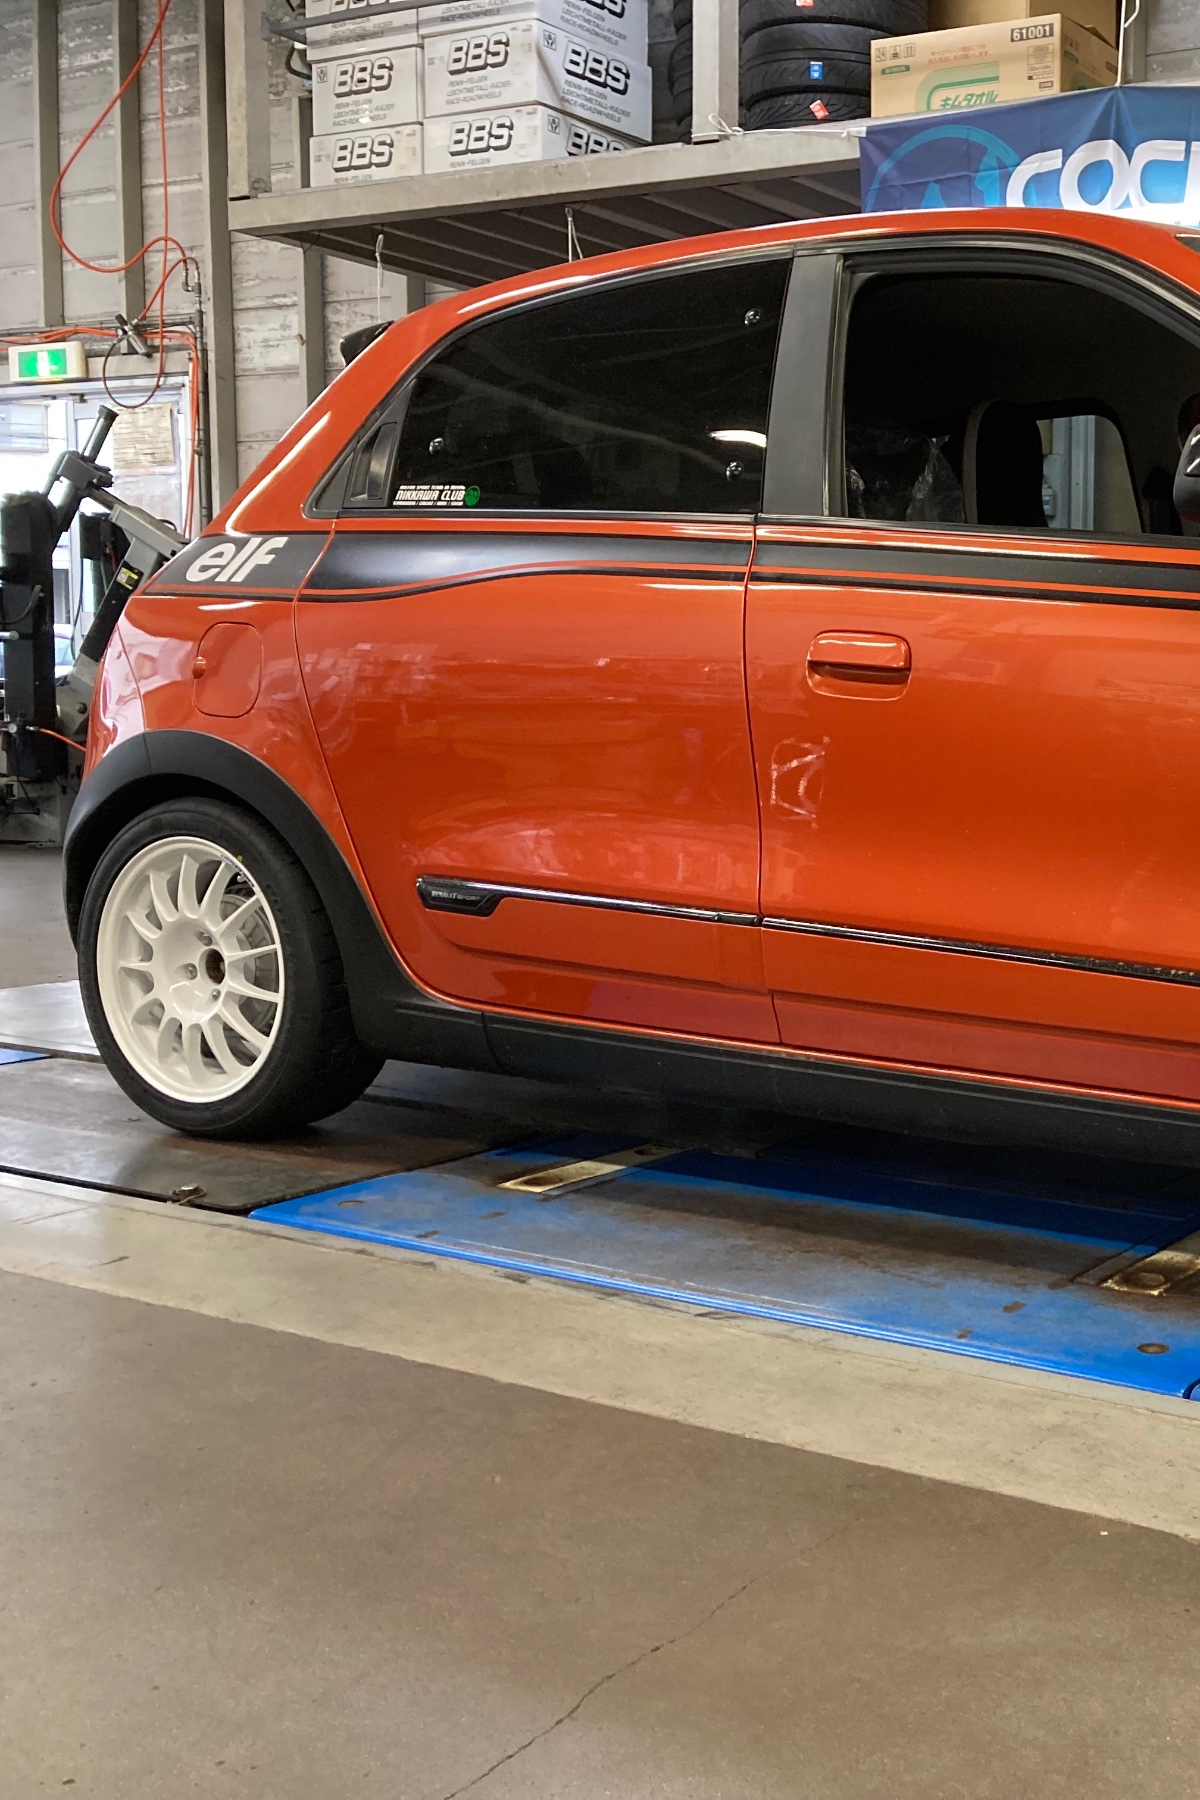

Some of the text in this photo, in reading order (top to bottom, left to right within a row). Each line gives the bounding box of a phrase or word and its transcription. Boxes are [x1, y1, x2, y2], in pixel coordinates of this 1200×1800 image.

[446, 31, 510, 76] BBS
[1012, 24, 1051, 41] 61001
[333, 56, 394, 98] BBS
[563, 40, 631, 96] BBS
[940, 89, 999, 109] キムタオル
[332, 133, 394, 173] BBS
[448, 115, 514, 157] BBS
[440, 490, 466, 501] CLUB
[186, 537, 288, 582] elf
